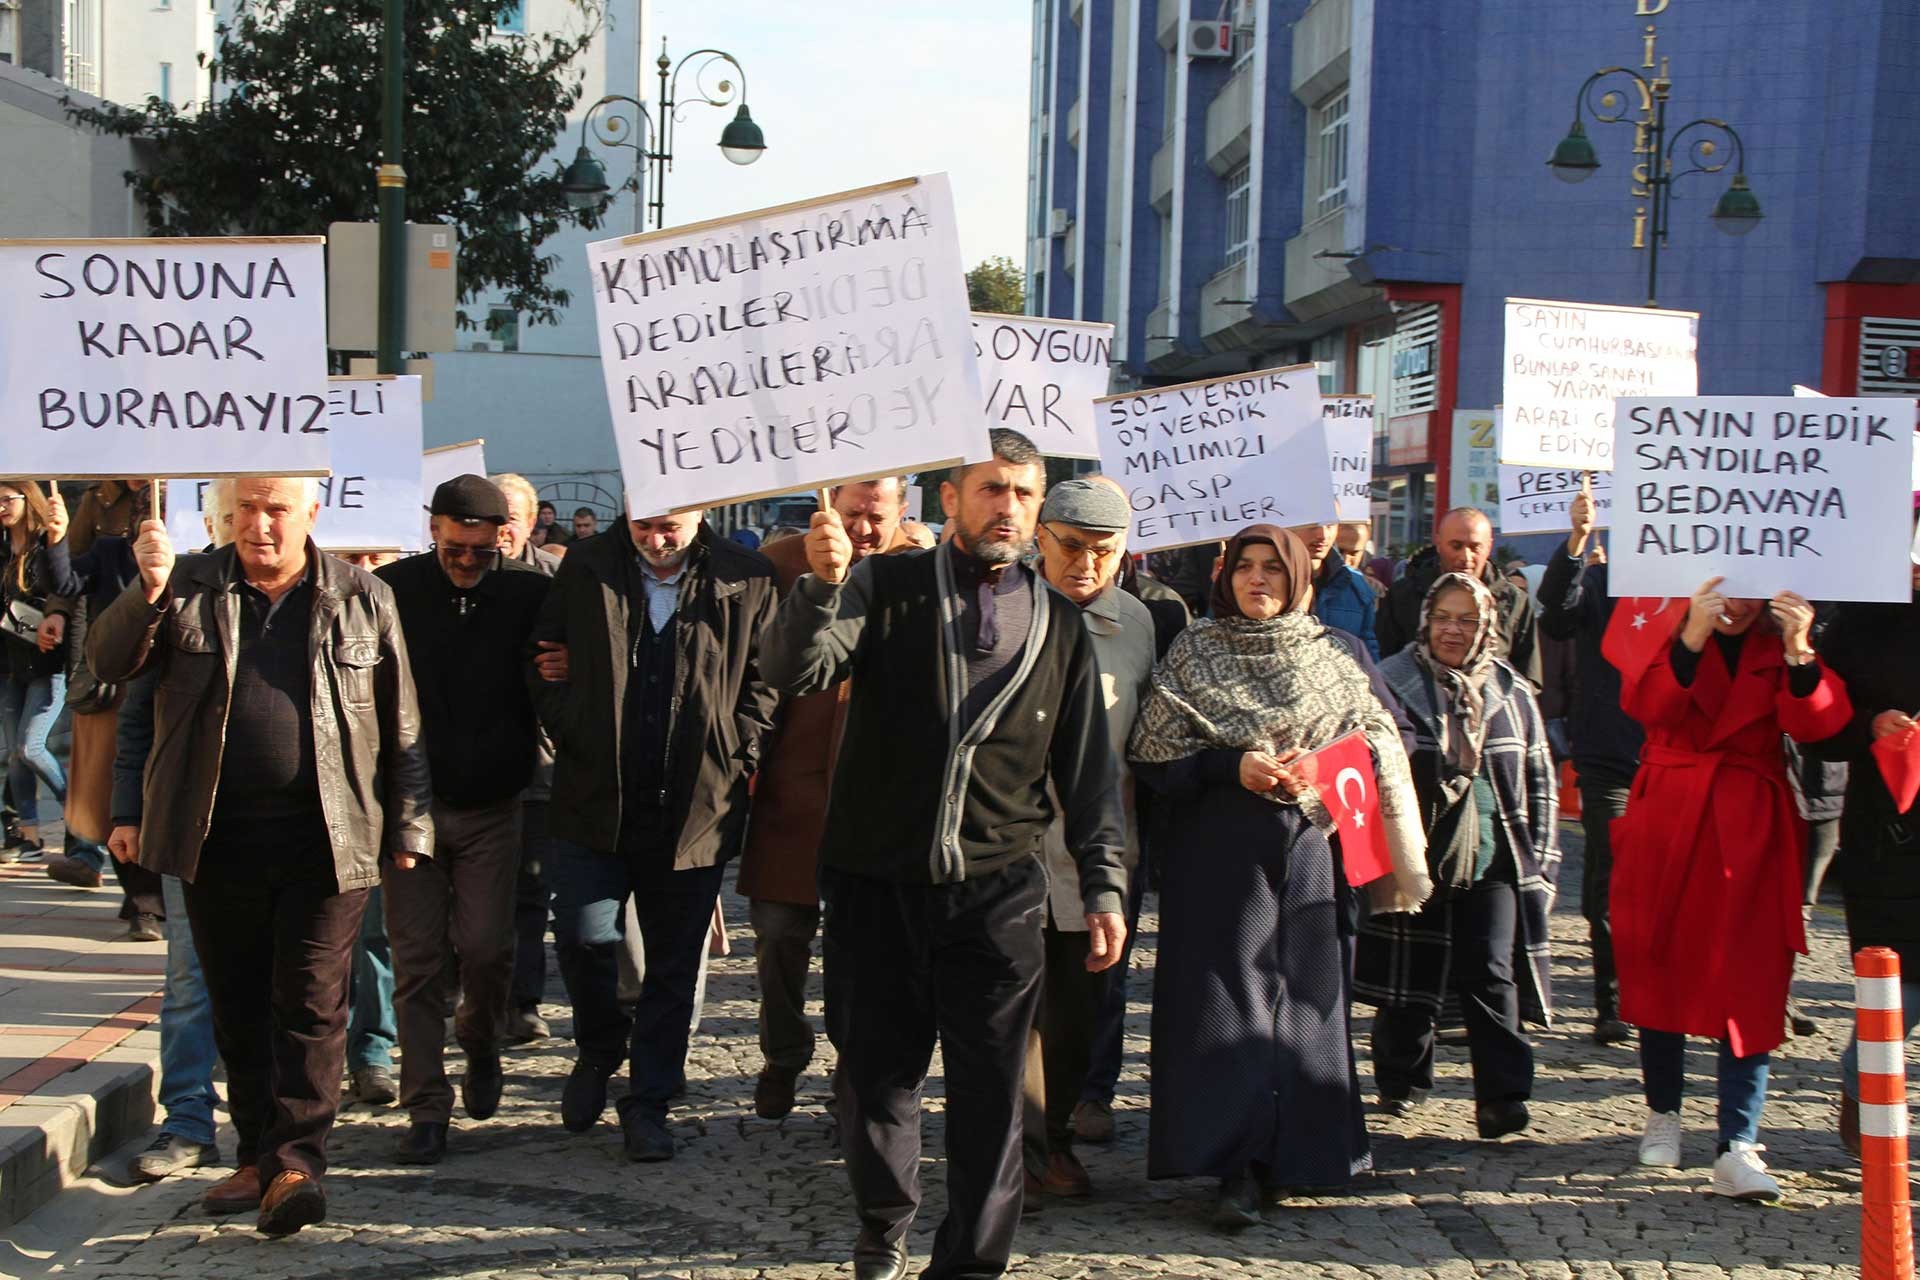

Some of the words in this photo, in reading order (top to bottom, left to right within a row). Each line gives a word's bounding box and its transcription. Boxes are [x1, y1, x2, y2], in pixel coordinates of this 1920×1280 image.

[35, 253, 296, 299] SONUNA
[599, 206, 928, 305] KAMULAŞTIRMA
[613, 291, 808, 360] DEDİLER
[1516, 305, 1586, 329] SAYIN
[78, 316, 265, 361] KADAR
[1513, 353, 1580, 377] BUNLAR
[38, 388, 330, 434] BURADAYIZ
[1117, 422, 1150, 446] OY
[1160, 401, 1266, 437] VERDİK
[1629, 406, 1753, 438] SAYIN
[1773, 405, 1896, 446] DEDİK
[639, 411, 865, 475] YEDİLER
[1125, 434, 1264, 475] MALIMIZI
[1636, 443, 1829, 475] SAYDILAR
[1130, 473, 1232, 511] GASP
[1636, 482, 1847, 520] BEDAVAYA
[1137, 496, 1285, 538] ETTİLER
[1636, 523, 1823, 558] ALDILAR
